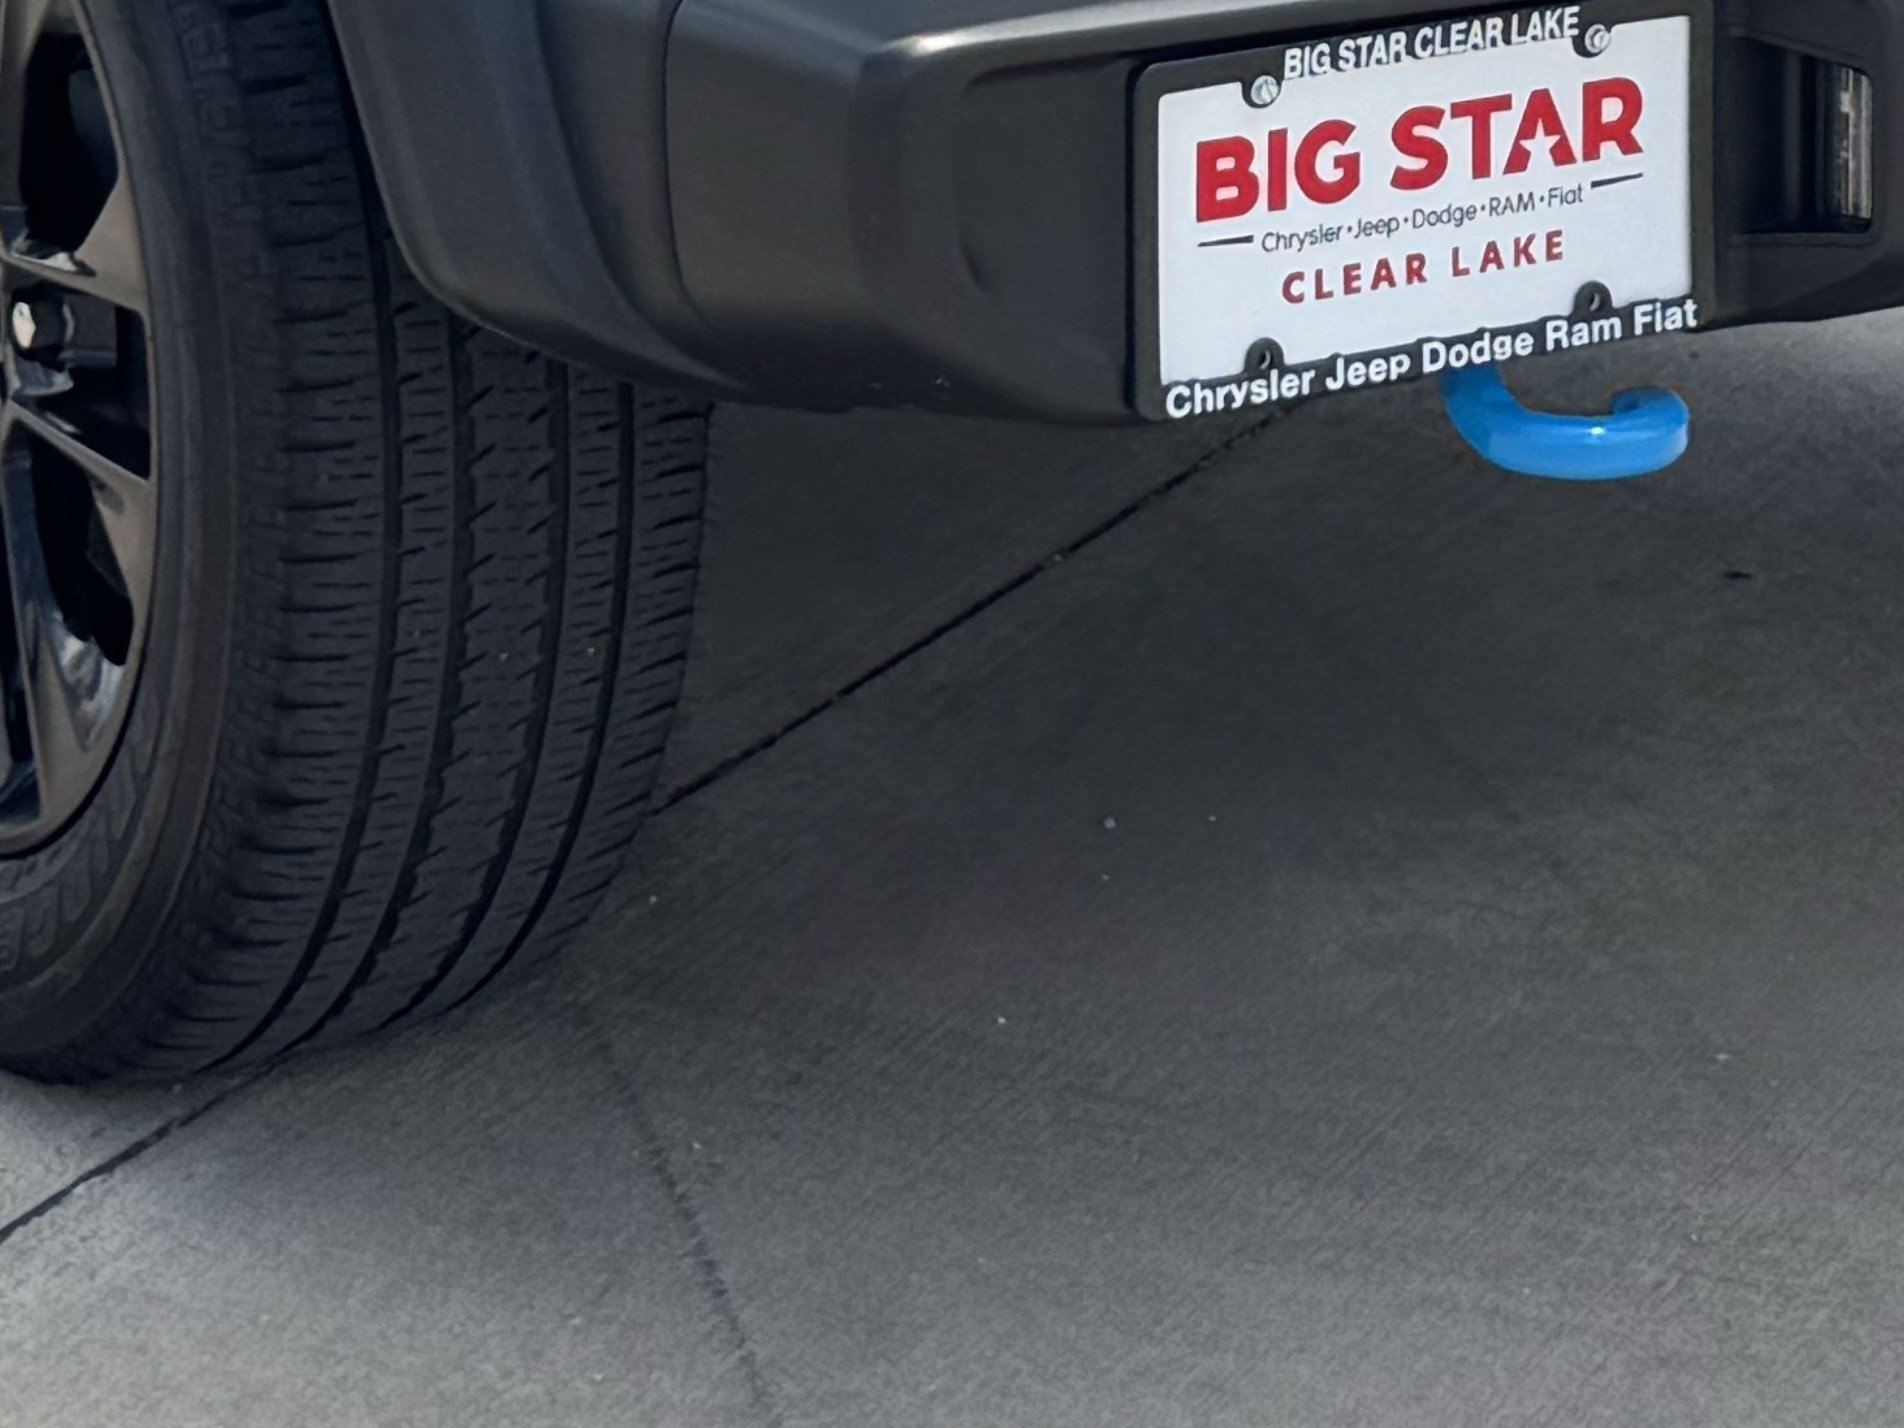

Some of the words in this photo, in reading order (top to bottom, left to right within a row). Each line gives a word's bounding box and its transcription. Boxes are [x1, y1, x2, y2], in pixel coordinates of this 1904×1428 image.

[1284, 42, 1331, 80] BIG
[1338, 30, 1407, 72] STAR
[1414, 15, 1503, 59] CLEAR
[1510, 5, 1581, 44] LAKE
[1196, 118, 1361, 223] BIG
[1389, 76, 1644, 191] STAR
[1260, 222, 1344, 253] Chrysler
[1353, 216, 1400, 240] Jeep
[1411, 202, 1478, 230] Dodge
[1488, 191, 1536, 217] RAM
[1281, 252, 1428, 304] CLEAR
[1451, 229, 1564, 277] LAKE
[1165, 367, 1316, 419] Chrysler
[1324, 352, 1412, 391] Jeep
[1421, 331, 1535, 374] Dodge
[1545, 315, 1622, 351] Ram
[1633, 298, 1698, 335] Fiat
